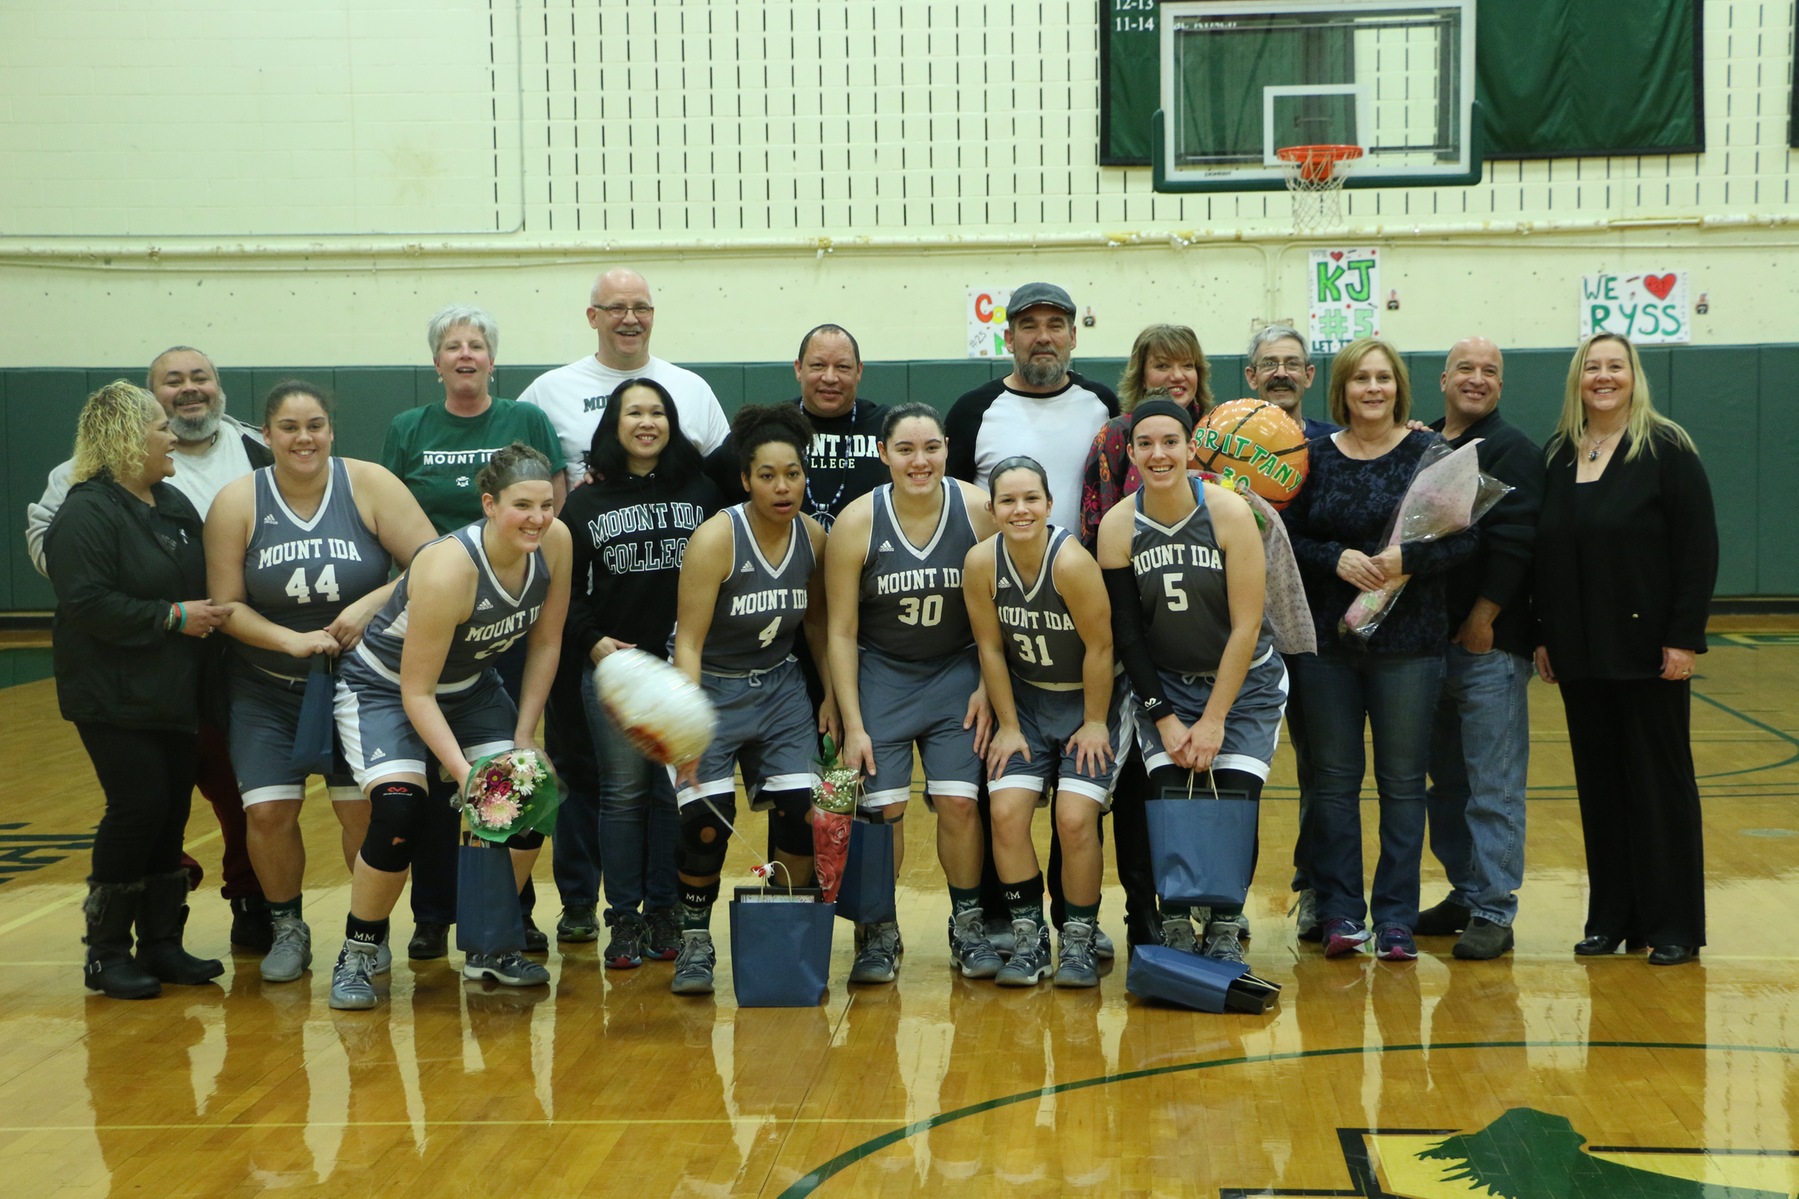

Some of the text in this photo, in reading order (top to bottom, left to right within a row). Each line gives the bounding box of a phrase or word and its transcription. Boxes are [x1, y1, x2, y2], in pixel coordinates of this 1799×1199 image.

[1115, 17, 1154, 31] 11-14
[1317, 259, 1376, 303] KJ
[1583, 275, 1619, 300] WE
[1318, 308, 1374, 339] #5
[1590, 303, 1681, 337] RYSS
[1312, 340, 1333, 352] LET
[583, 395, 611, 413] MO
[423, 454, 476, 466] MOUNT
[587, 503, 668, 549] MOUNT
[258, 538, 362, 570] MOUNT IDA
[1131, 544, 1223, 577] MOUNT IDA
[285, 564, 340, 604] 44
[877, 567, 964, 595] MOUNT ID
[1163, 572, 1188, 611] 5
[730, 589, 788, 616] MOUNT
[898, 595, 944, 627] 30
[464, 610, 526, 642] MOUNT
[758, 616, 782, 648] 4
[1043, 610, 1075, 630] IDA
[1013, 632, 1054, 666] 31
[685, 892, 707, 903] MM
[354, 930, 375, 942] MM
